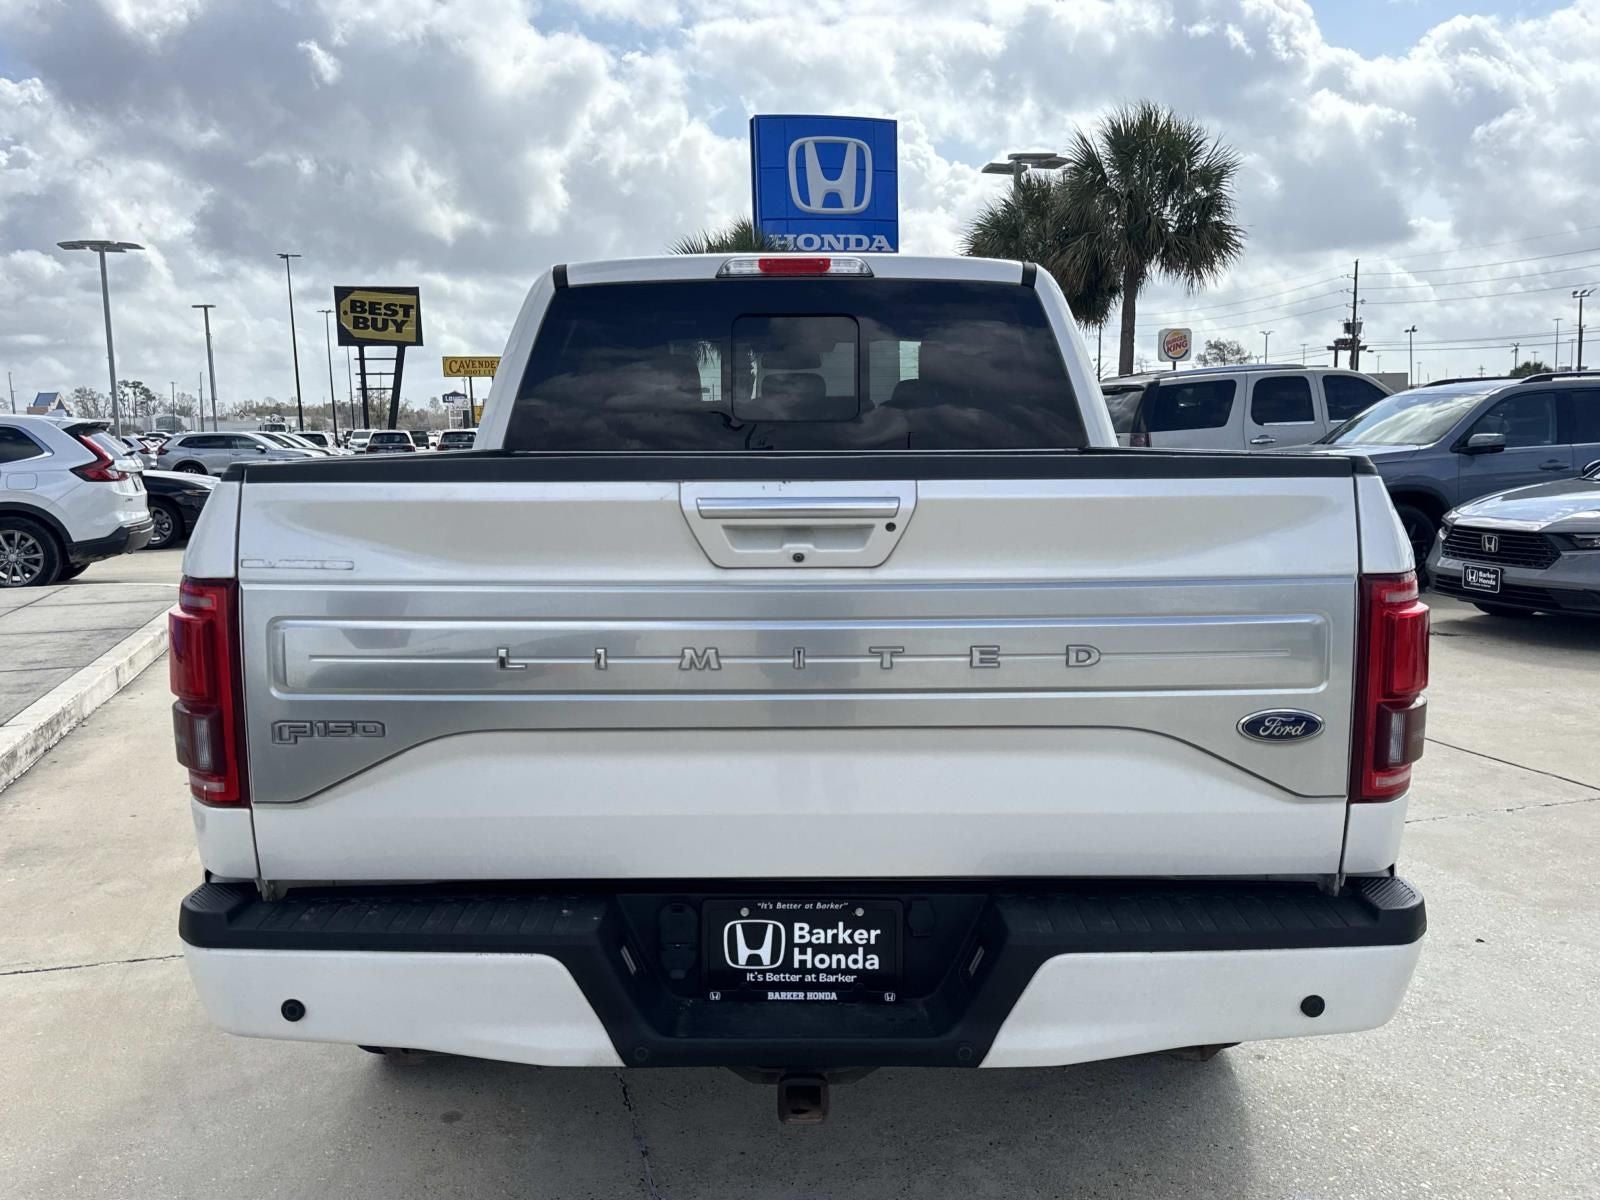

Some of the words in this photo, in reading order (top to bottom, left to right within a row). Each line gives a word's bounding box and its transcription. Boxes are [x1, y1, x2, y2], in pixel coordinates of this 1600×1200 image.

[768, 234, 895, 252] HONDA
[350, 299, 414, 318] BEST
[352, 315, 409, 334] BUY
[1167, 341, 1188, 353] KING
[497, 644, 1101, 670] LIMITED
[1259, 716, 1306, 736] Ford
[776, 902, 802, 910] Better
[793, 921, 881, 945] Barker
[793, 947, 880, 969] Honda
[746, 971, 764, 982] It's
[765, 972, 802, 982] Better
[804, 973, 817, 982] at
[819, 973, 857, 983] Barker
[767, 991, 805, 1000] BARKER
[806, 991, 838, 1000] HONDA
